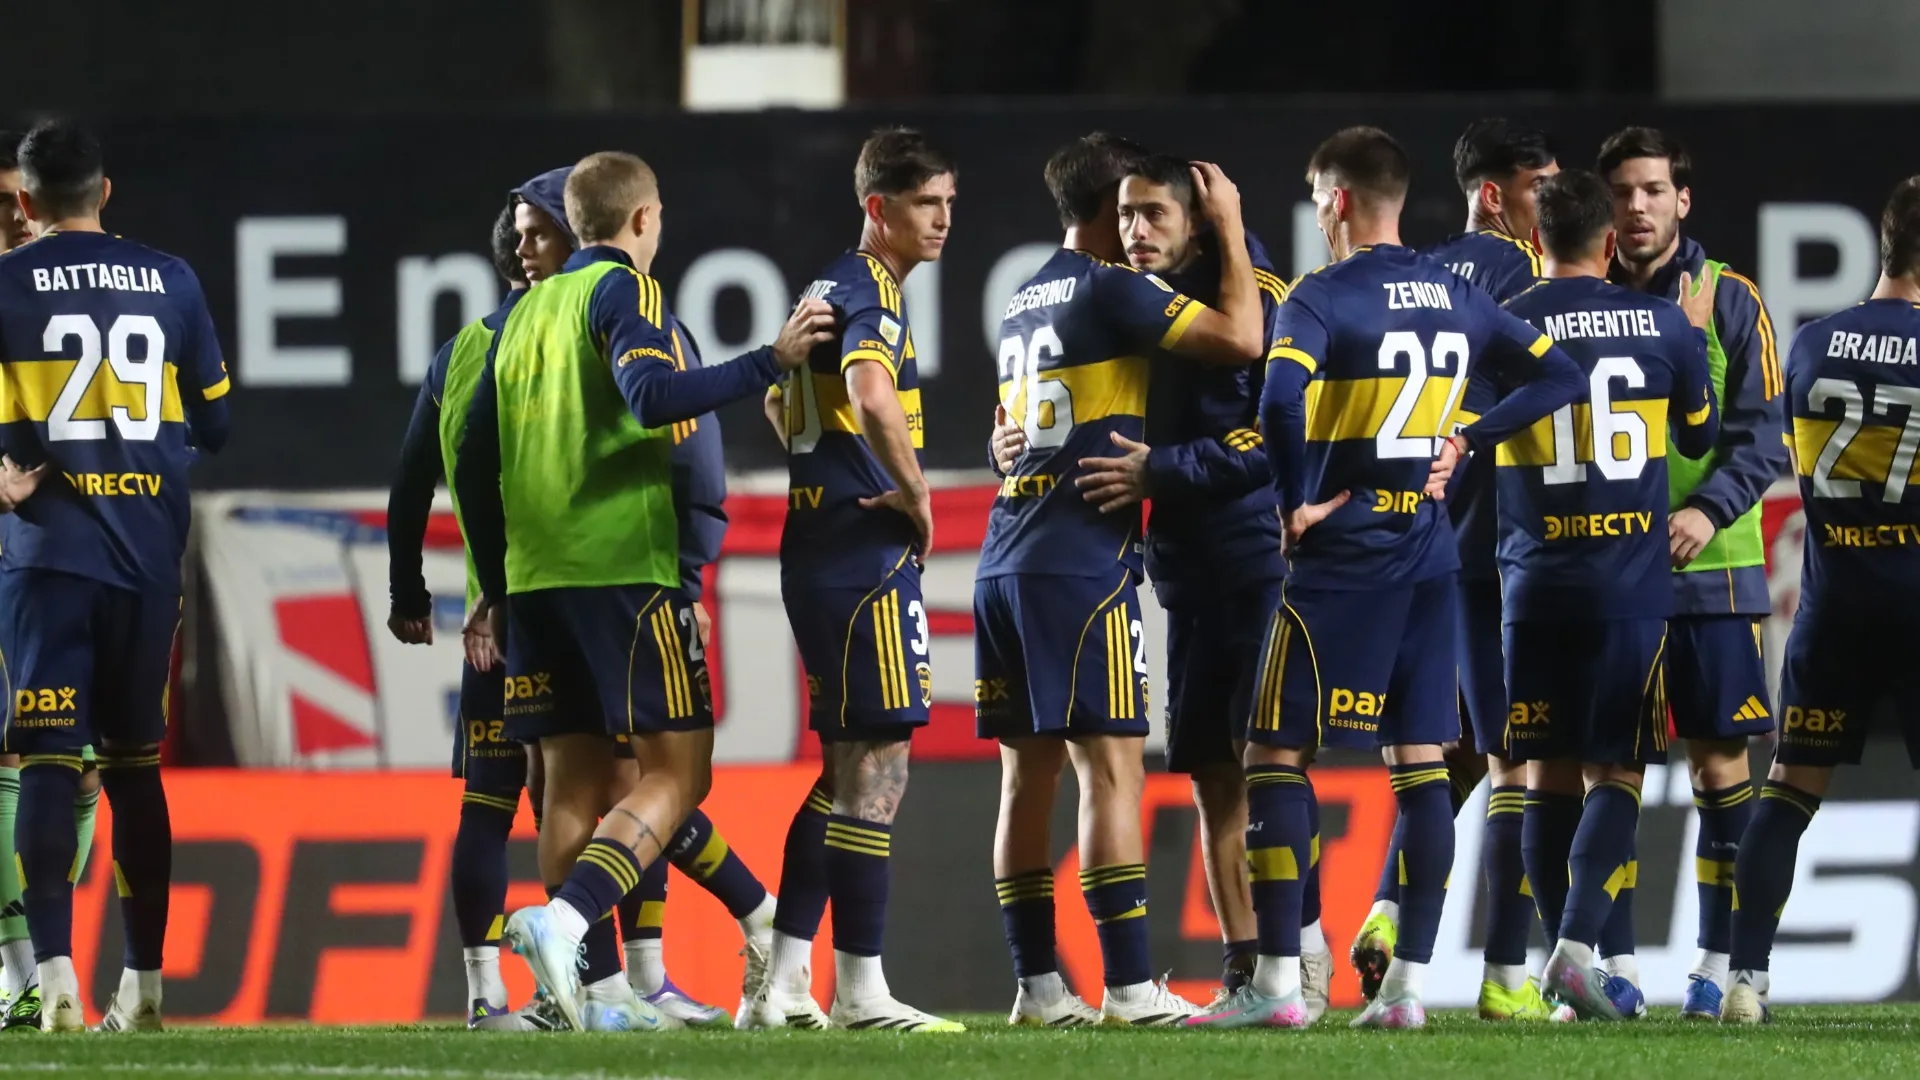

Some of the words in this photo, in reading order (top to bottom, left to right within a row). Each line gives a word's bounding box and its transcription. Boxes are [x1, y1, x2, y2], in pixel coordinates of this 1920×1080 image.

[33, 263, 166, 294] BATTAGLIA
[1383, 281, 1452, 310] ZENON
[1544, 309, 1661, 342] MERENTIEL
[1826, 330, 1919, 366] BRAIDA
[43, 314, 165, 441] 29
[1375, 331, 1470, 459] 22
[1543, 357, 1647, 485] 16
[1807, 377, 1920, 504] 27
[1543, 511, 1652, 541] DIRECTV
[15, 686, 77, 718] pax
[1508, 700, 1551, 725] ax
[14, 717, 76, 728] assistance
[1783, 705, 1847, 734] pax
